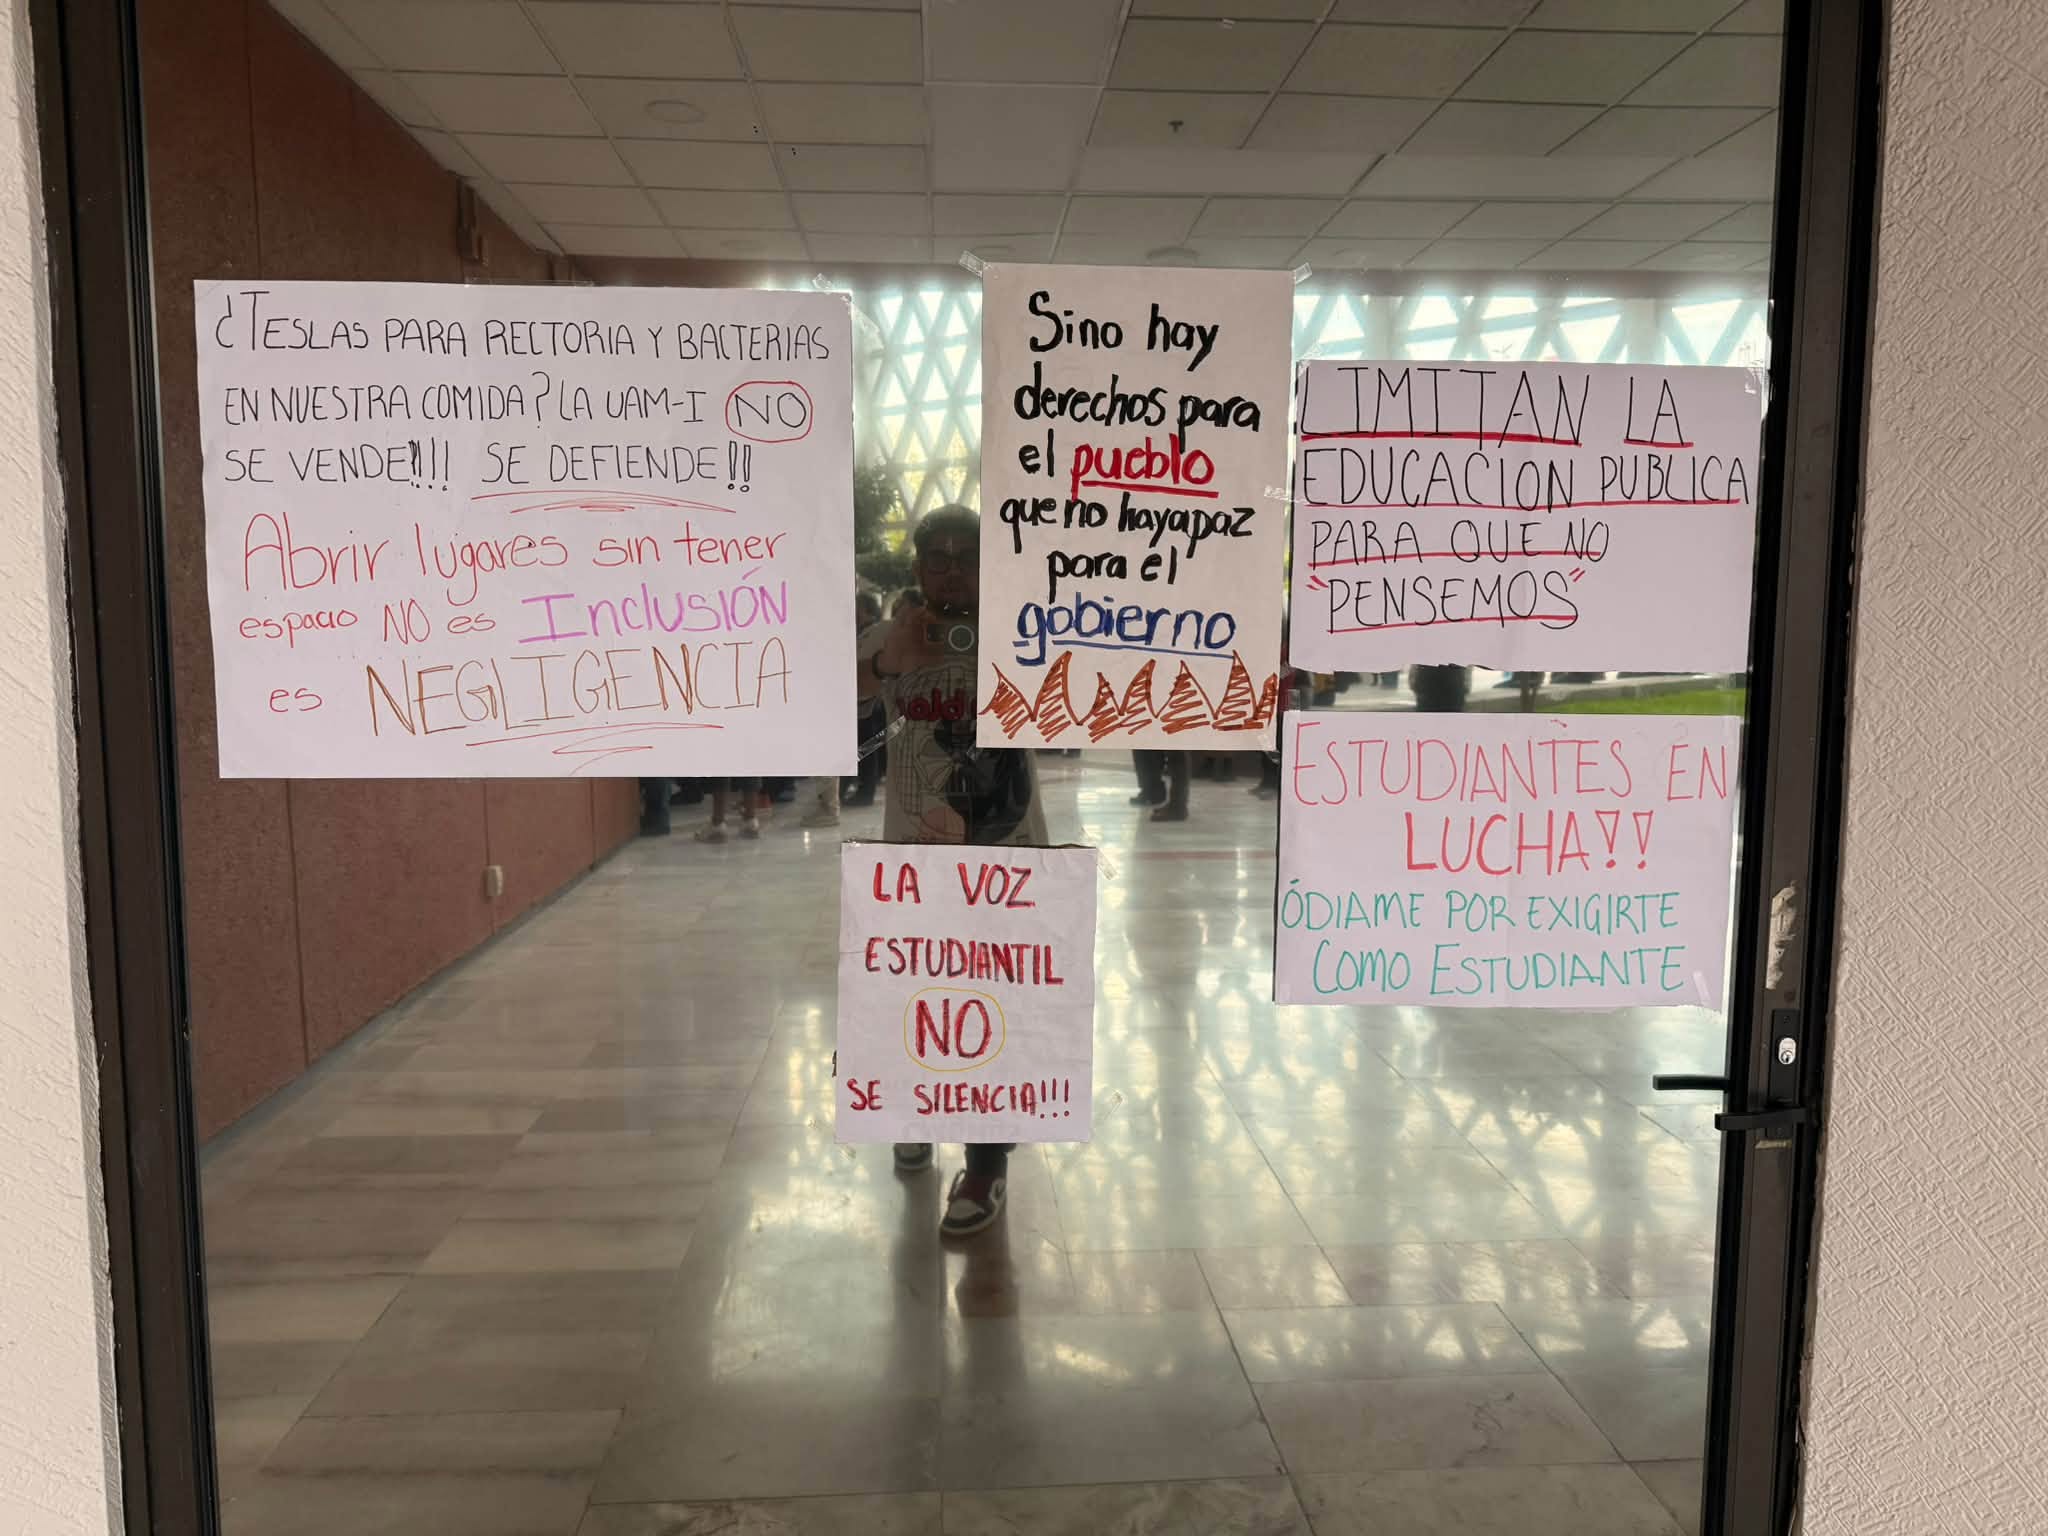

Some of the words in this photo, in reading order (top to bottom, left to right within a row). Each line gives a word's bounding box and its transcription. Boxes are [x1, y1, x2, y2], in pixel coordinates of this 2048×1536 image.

[385, 319, 467, 357] PARA
[485, 319, 635, 355] RECTORIA
[648, 326, 662, 357] Y
[677, 323, 829, 361] BACTERIAS
[1147, 303, 1219, 371] hay
[225, 388, 258, 425] EN
[271, 385, 411, 423] NUESTRA
[560, 380, 592, 421] LA
[607, 386, 706, 422] UAM-I
[734, 392, 806, 428] NO
[1014, 361, 1168, 426] derechos
[1177, 395, 1261, 453] para
[1300, 367, 1589, 450] LIMITAN
[1624, 376, 1684, 446] LA
[225, 448, 274, 482] SE
[482, 442, 530, 484] SE
[550, 440, 751, 492] DEFIENDE!!
[1018, 428, 1054, 477] el
[1071, 433, 1215, 502] pueblo
[1303, 447, 1573, 513] EDUCACION
[1600, 454, 1748, 504] PUBLICA
[1000, 497, 1056, 554] que
[1064, 499, 1108, 528] no
[1311, 520, 1422, 570] PARA
[1451, 521, 1542, 563] QUE
[1565, 518, 1610, 562] NO
[245, 512, 391, 592] Abrir
[415, 523, 568, 606] lugares
[593, 535, 660, 566] sin
[674, 521, 787, 566] tener
[1046, 550, 1127, 603] para
[1140, 545, 1177, 584] el
[239, 610, 358, 649] espacio
[383, 598, 430, 645] NO
[447, 613, 496, 633] es
[1016, 592, 1236, 666] gobierno
[269, 688, 322, 713] es
[366, 636, 793, 736] NEGLIGENCIA
[1667, 744, 1728, 801] EN
[1405, 810, 1654, 875] LUCHA!!
[873, 862, 921, 904] LA
[957, 863, 1036, 908] VOZ
[1447, 890, 1516, 932] POR
[1527, 891, 1681, 935] EXIGIRTE
[865, 936, 1064, 985] ESTUDIANTIL
[915, 998, 993, 1059] NO
[847, 1078, 882, 1111] SE
[914, 1078, 1070, 1119] SILENCIA!!!
